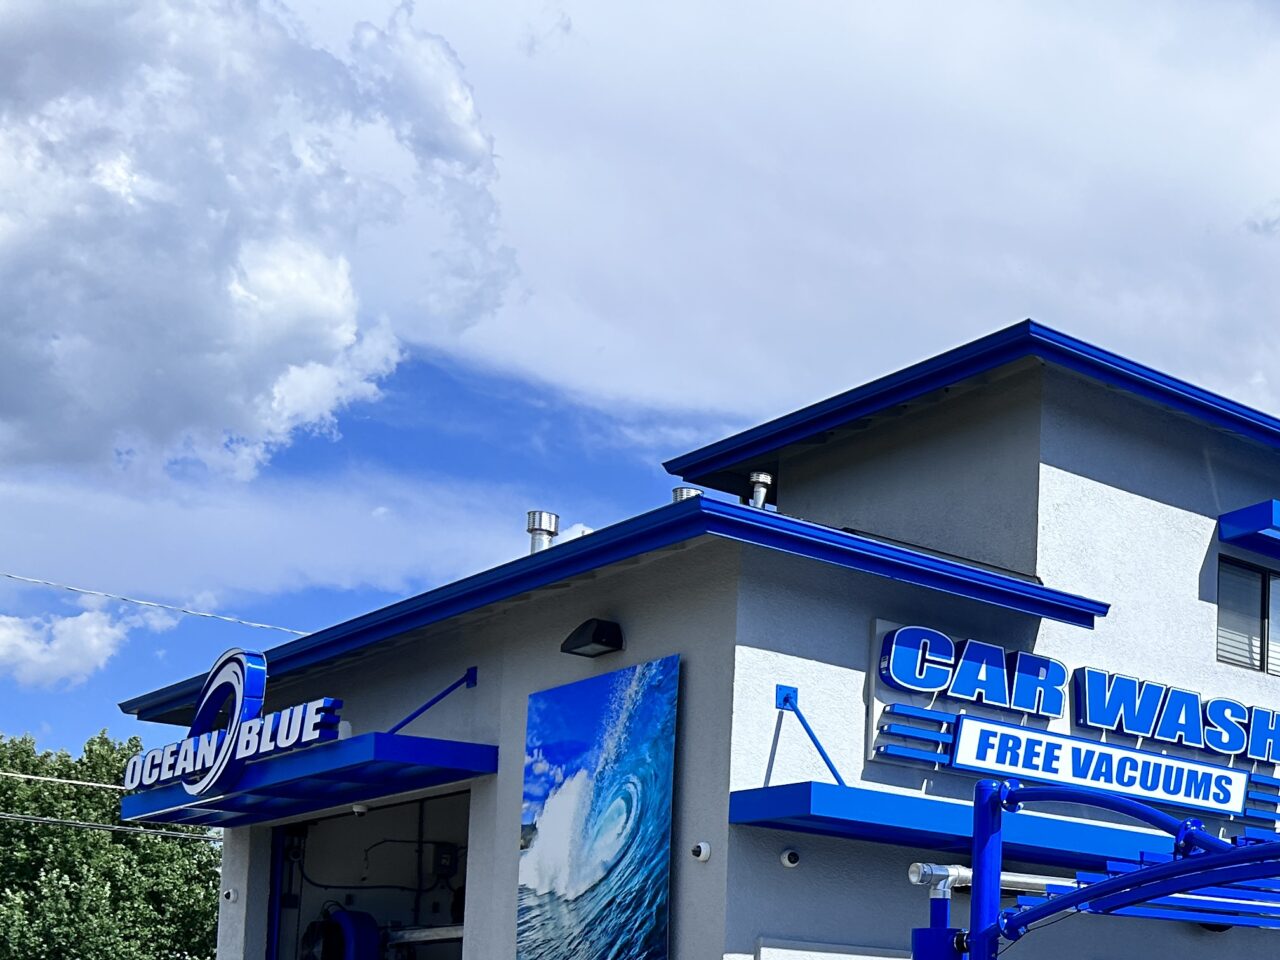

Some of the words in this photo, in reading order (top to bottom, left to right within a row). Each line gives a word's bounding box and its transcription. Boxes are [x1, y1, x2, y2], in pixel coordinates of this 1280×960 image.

[887, 626, 1068, 720] CAR
[124, 731, 220, 790] OCEAN
[235, 698, 326, 760] BLUE
[975, 729, 1061, 773] FREE
[1070, 747, 1233, 805] VACUUMS
